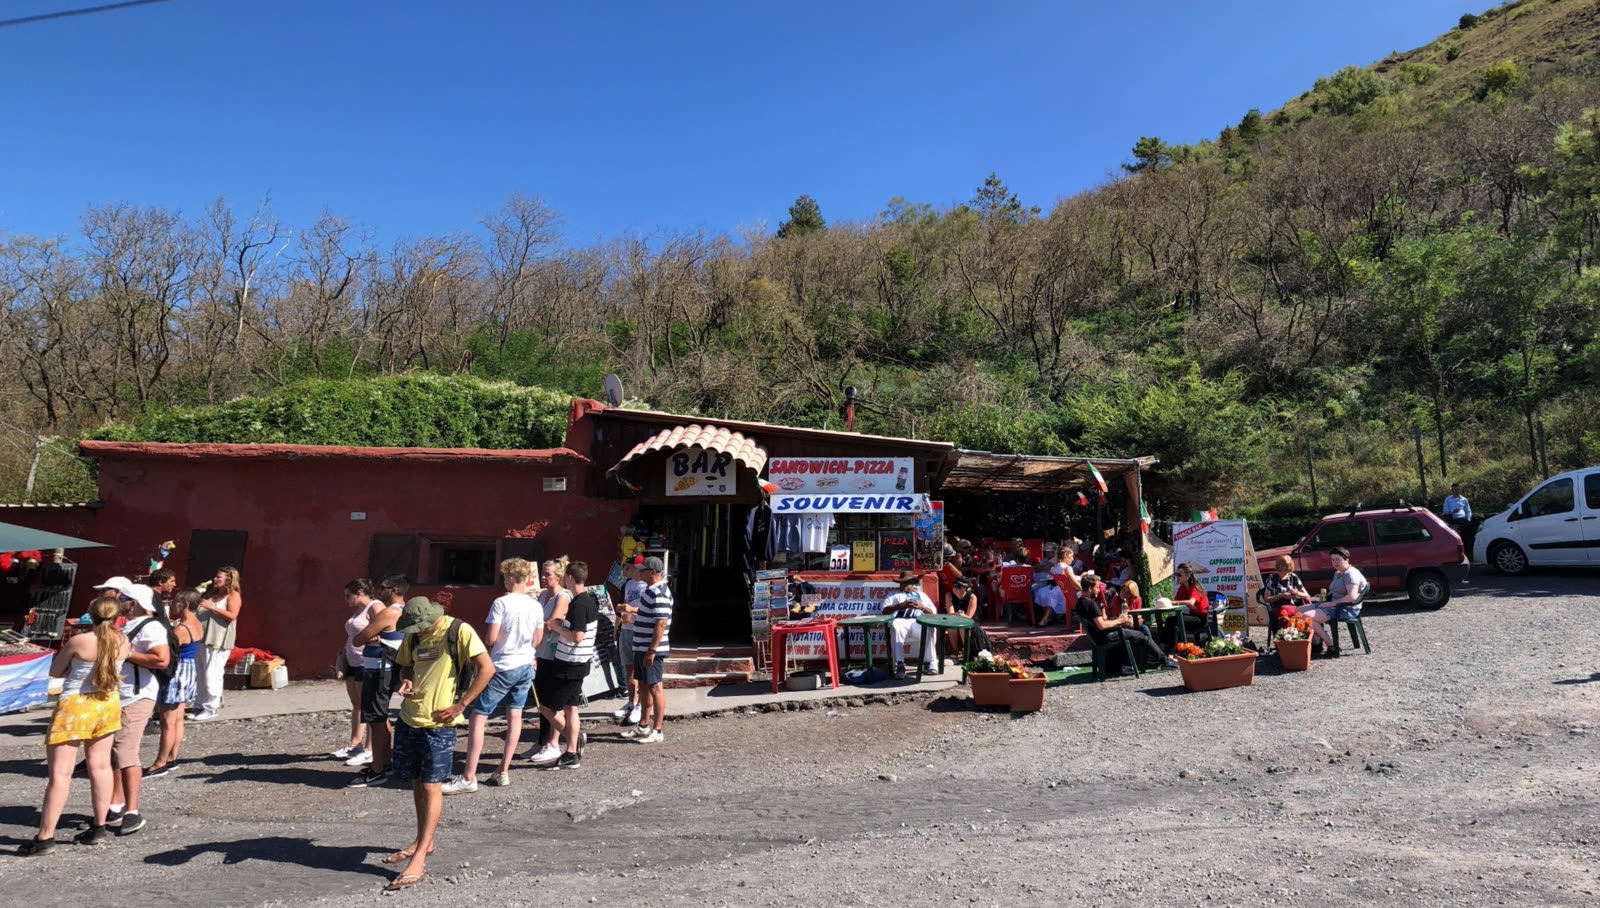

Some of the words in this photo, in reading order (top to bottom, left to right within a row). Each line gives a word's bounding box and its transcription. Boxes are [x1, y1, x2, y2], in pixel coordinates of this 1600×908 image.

[672, 450, 732, 477] BAR
[769, 459, 895, 475] SANDWICH-PIZZA
[777, 496, 914, 511] SOUVENIR
[883, 537, 908, 545] PIZZA
[1208, 557, 1243, 565] CAPPUCCINO
[1216, 566, 1236, 574] COFFEE
[1210, 575, 1219, 583] ICE
[844, 587, 866, 600] DEL
[838, 602, 864, 611] CRISTI
[866, 602, 881, 611] DEL
